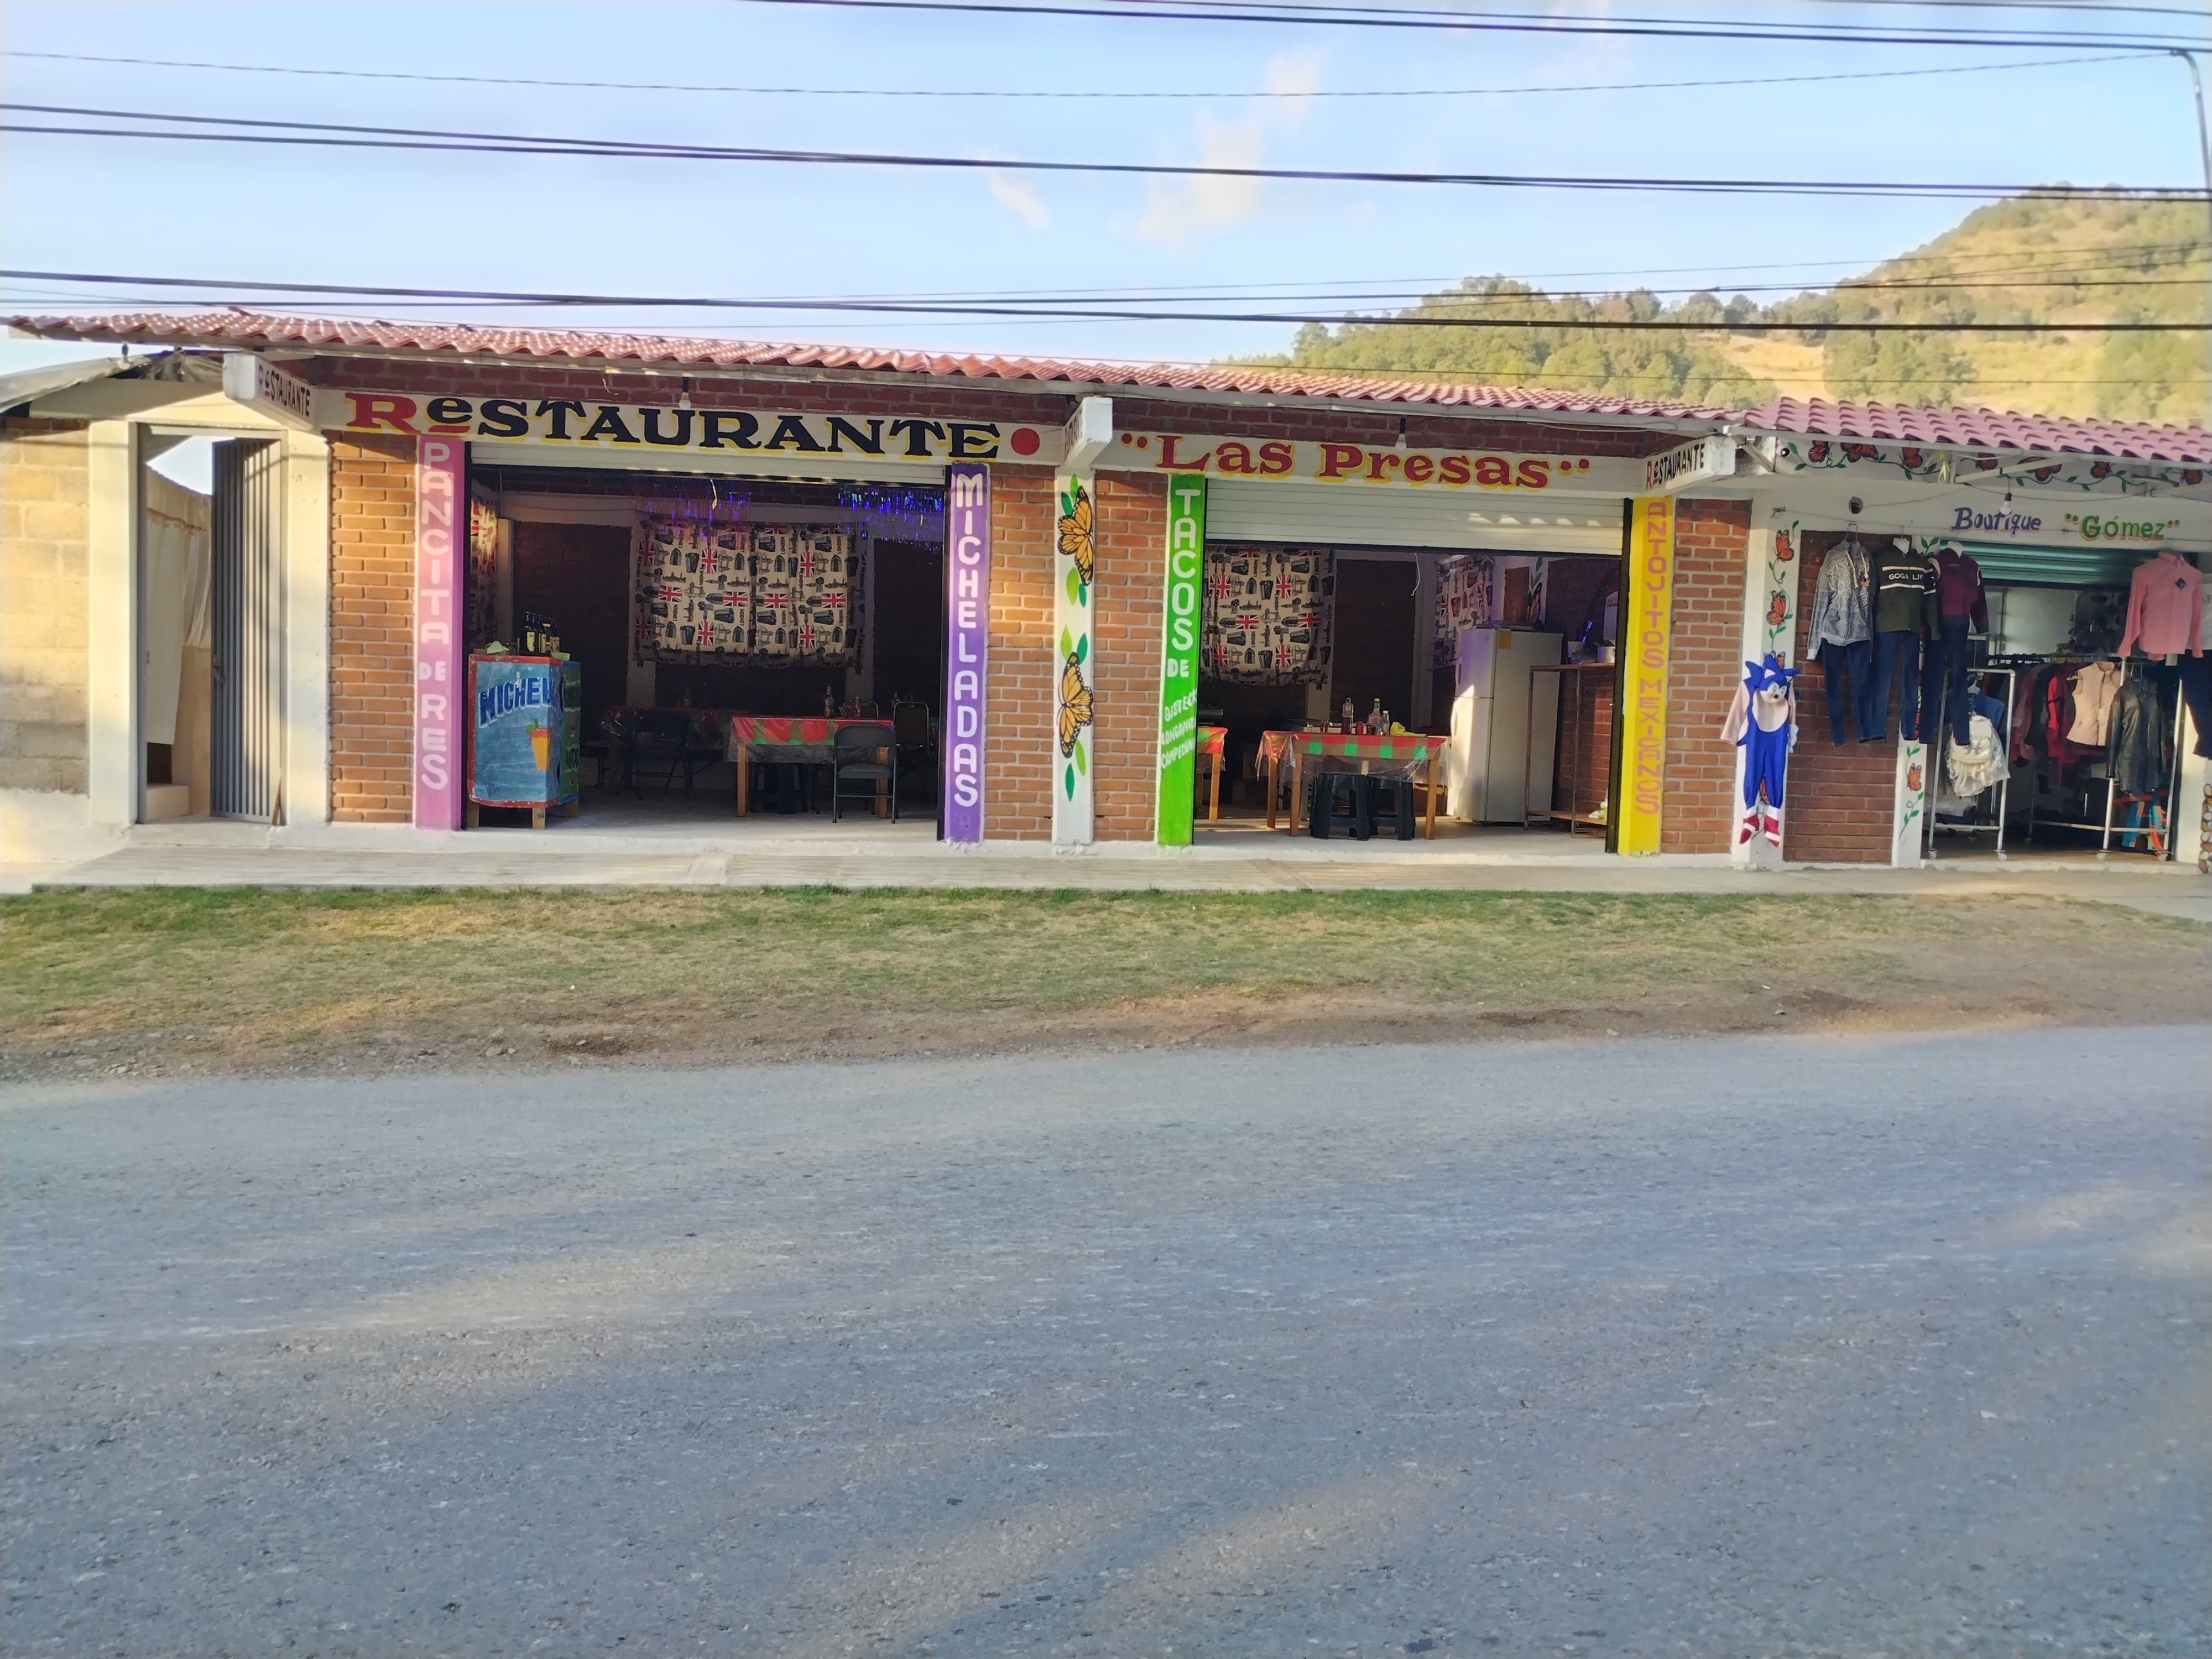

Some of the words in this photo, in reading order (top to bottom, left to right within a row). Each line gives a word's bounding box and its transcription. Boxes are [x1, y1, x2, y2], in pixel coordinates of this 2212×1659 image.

[420, 441, 453, 644] PANCITA
[1171, 488, 1201, 651] TACOS
[1641, 502, 1667, 669] ANTOJITOS
[1951, 507, 2042, 535] Boutique
[418, 660, 447, 681] DE
[954, 473, 984, 807] MICHELADAS
[1166, 658, 1190, 678] DE
[421, 693, 448, 790] RES
[1635, 679, 1662, 815] MEXICANOS
